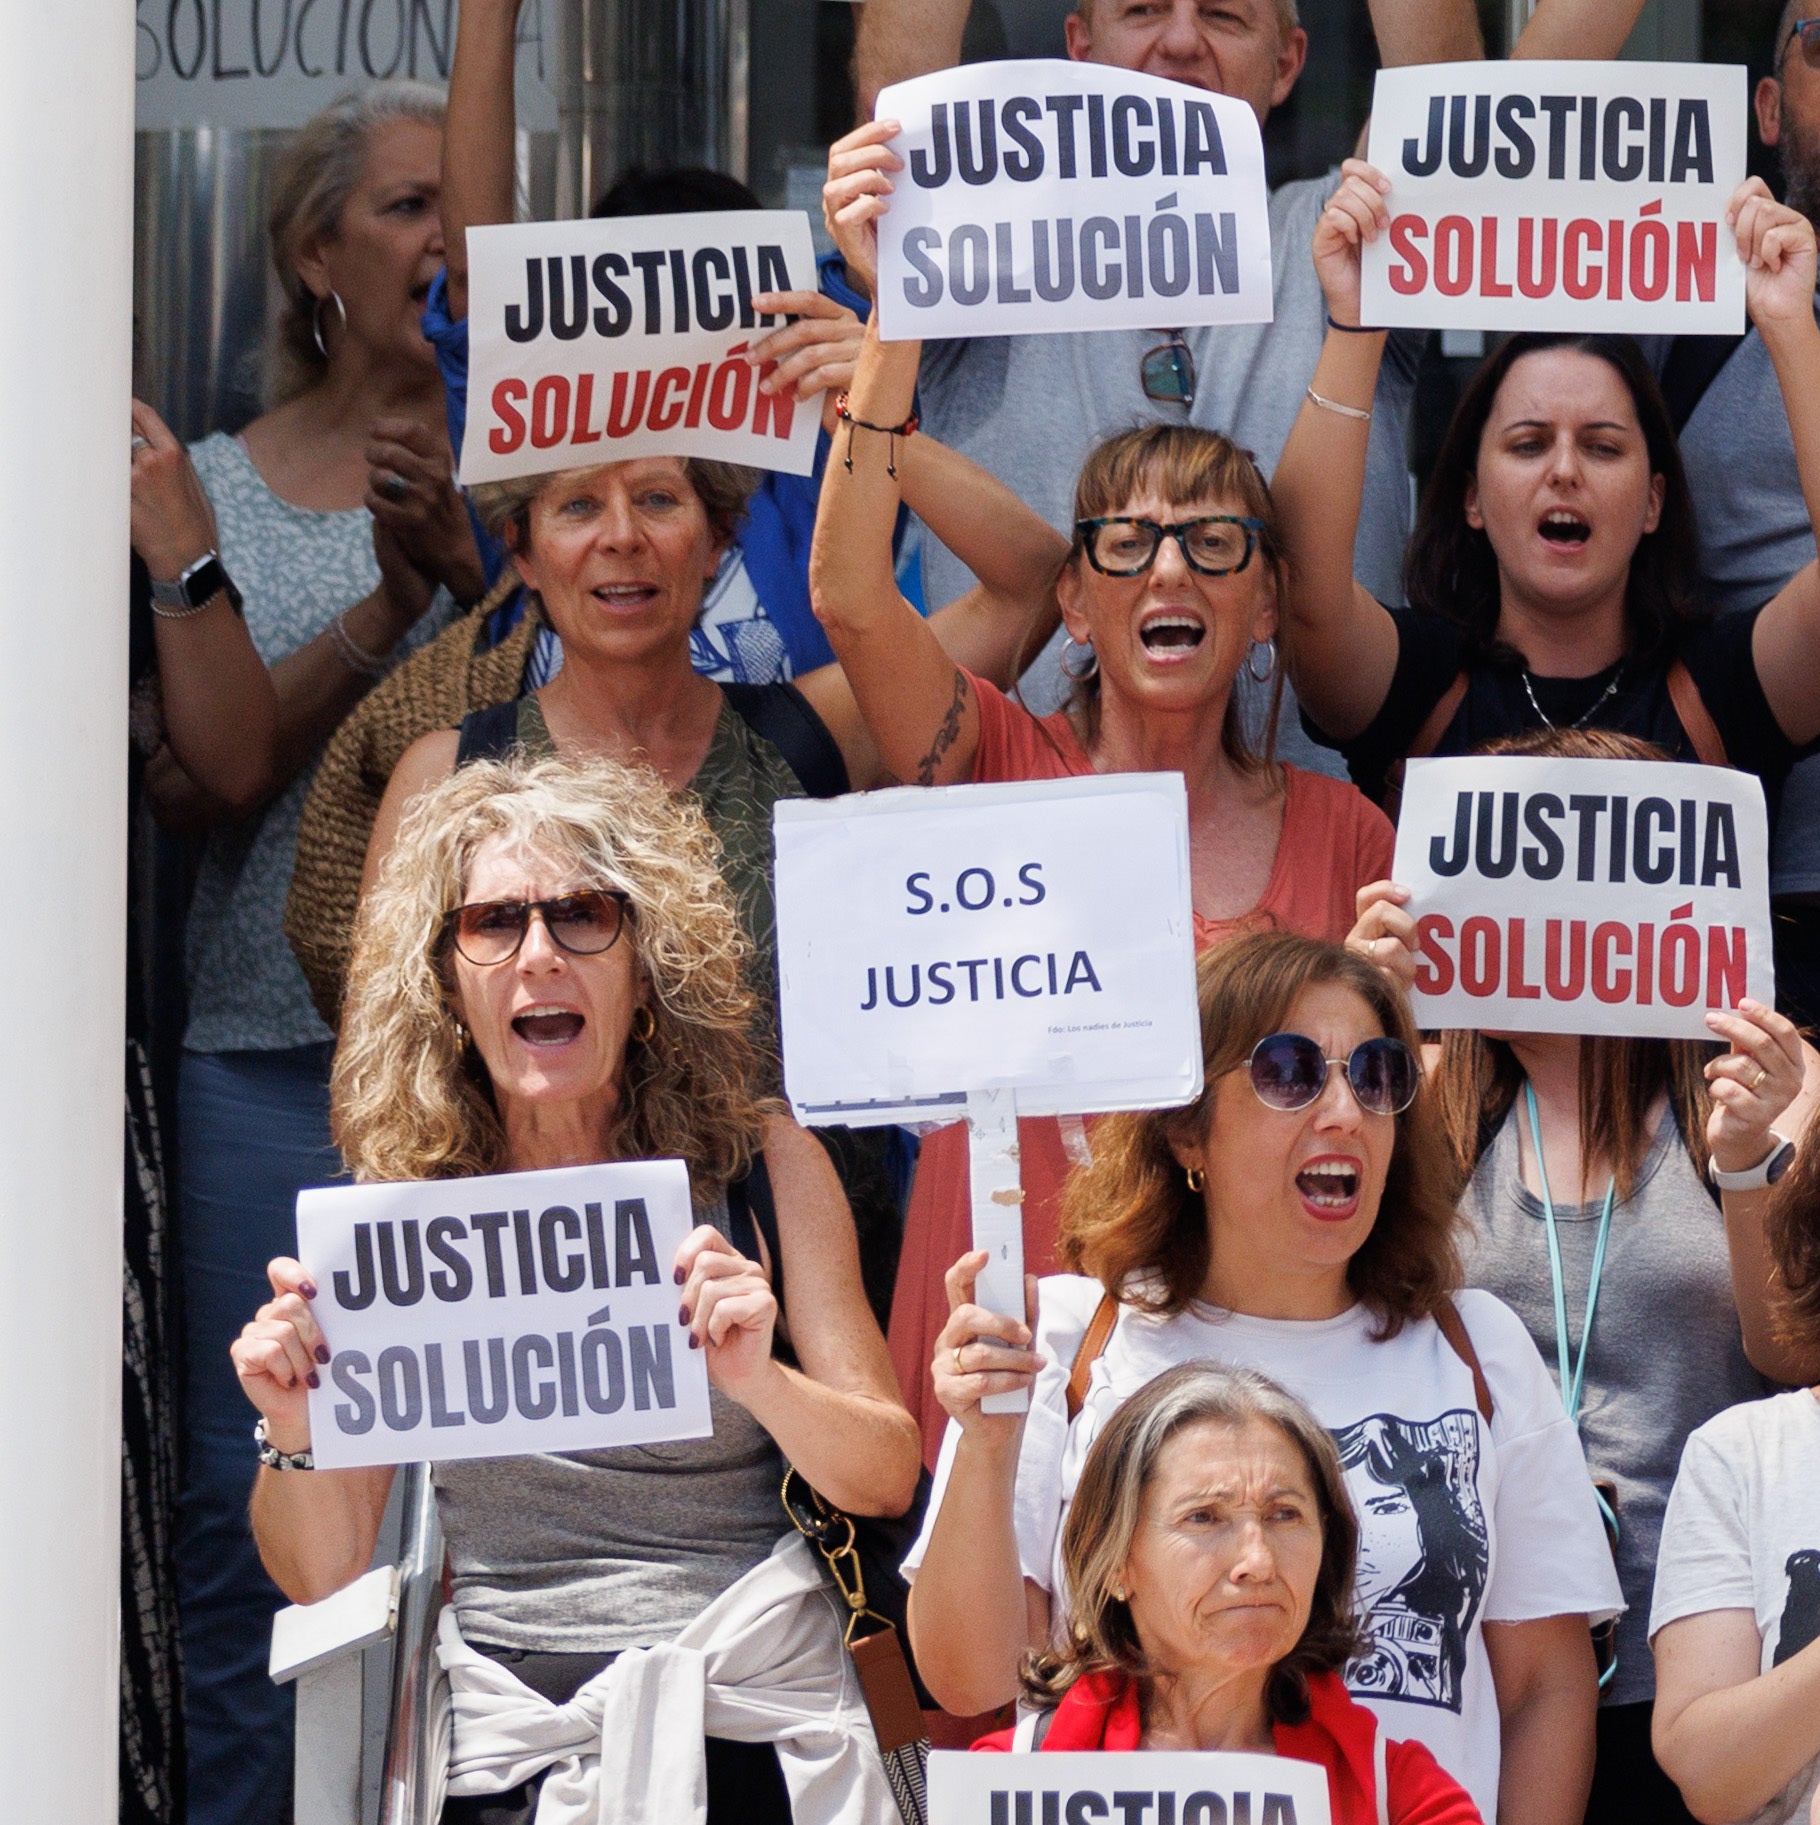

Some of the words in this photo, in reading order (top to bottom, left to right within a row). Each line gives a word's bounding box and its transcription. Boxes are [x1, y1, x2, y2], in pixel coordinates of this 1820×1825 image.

[910, 94, 1228, 189] JUSTICIA
[1402, 94, 1715, 183] JUSTICIA
[504, 245, 800, 344] JUSTICIA
[902, 191, 1240, 308] SOLUCIÓN
[1388, 198, 1717, 302] SOLUCIÓN
[488, 340, 799, 455] SOLUCIÓN
[905, 862, 1046, 915] S.O.S
[1429, 791, 1741, 889] JUSTICIA
[860, 950, 1103, 1011] JUSTICIA
[1415, 901, 1747, 1009] SOLUCIÓN
[1111, 1021, 1121, 1029] de
[332, 1197, 661, 1311] JUSTICIA
[331, 1305, 676, 1436] SOLUCIÓN
